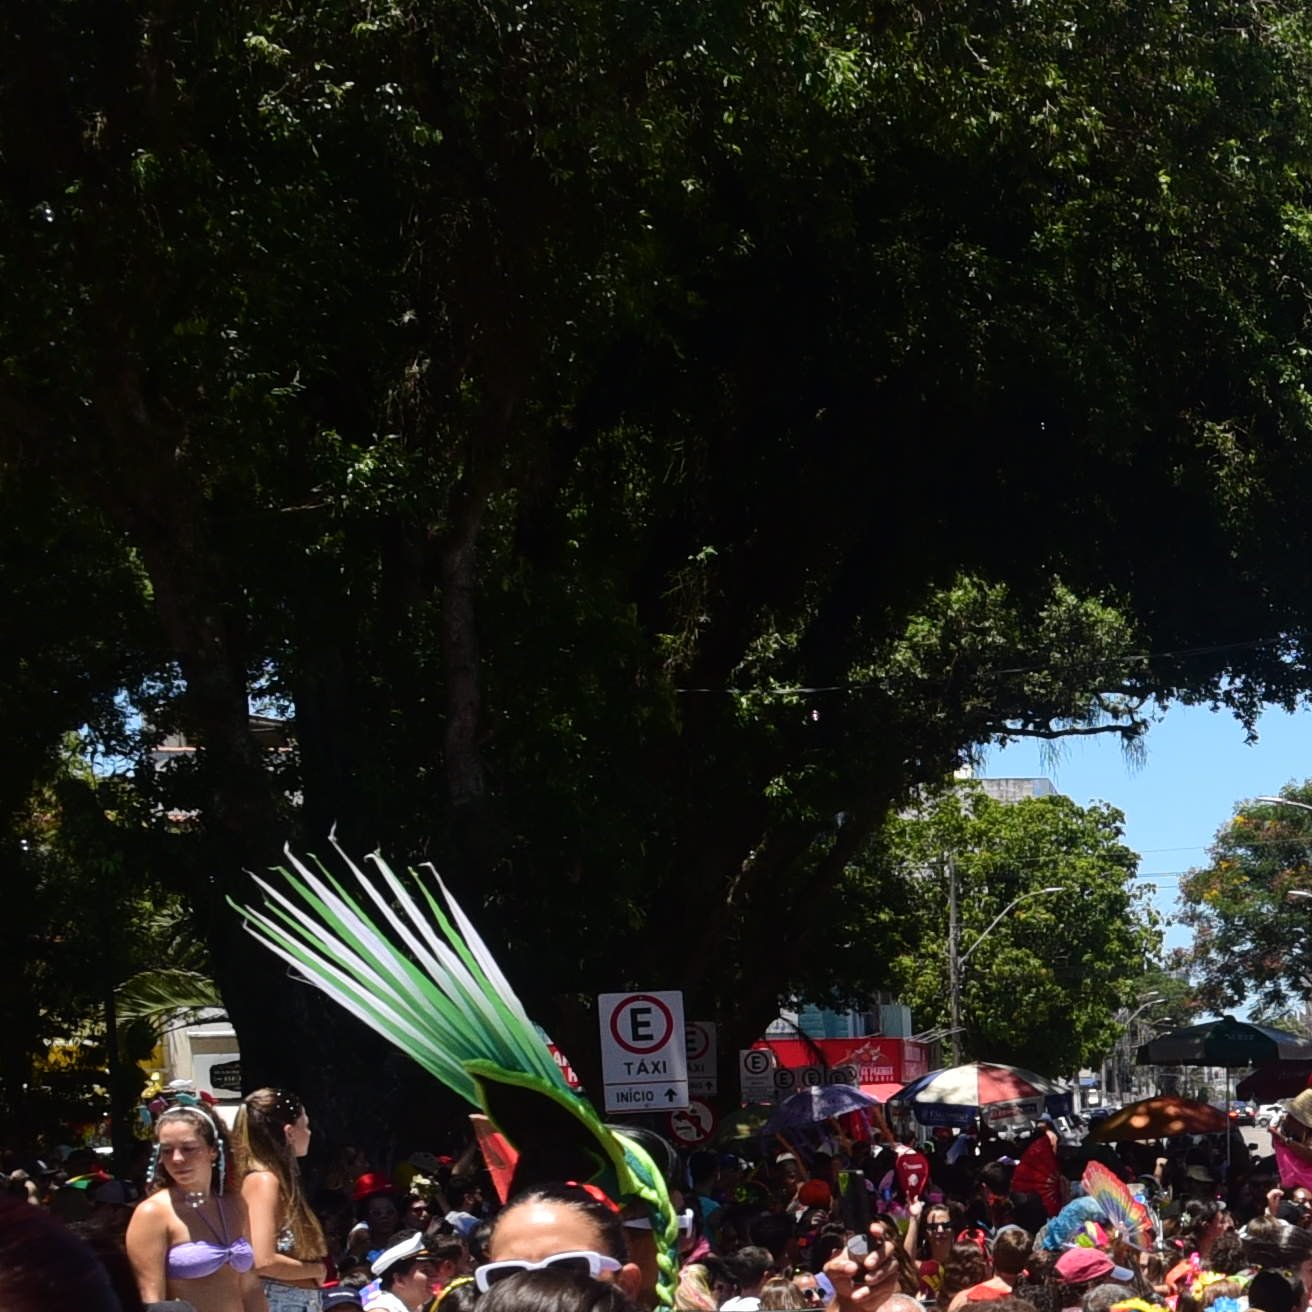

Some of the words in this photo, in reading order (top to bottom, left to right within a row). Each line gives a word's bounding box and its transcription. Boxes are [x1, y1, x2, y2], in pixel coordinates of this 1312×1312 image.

[630, 1007, 654, 1041] E
[624, 1058, 667, 1076] TÁXI
[751, 1056, 762, 1070] E
[616, 1088, 654, 1104] INÍCIO
